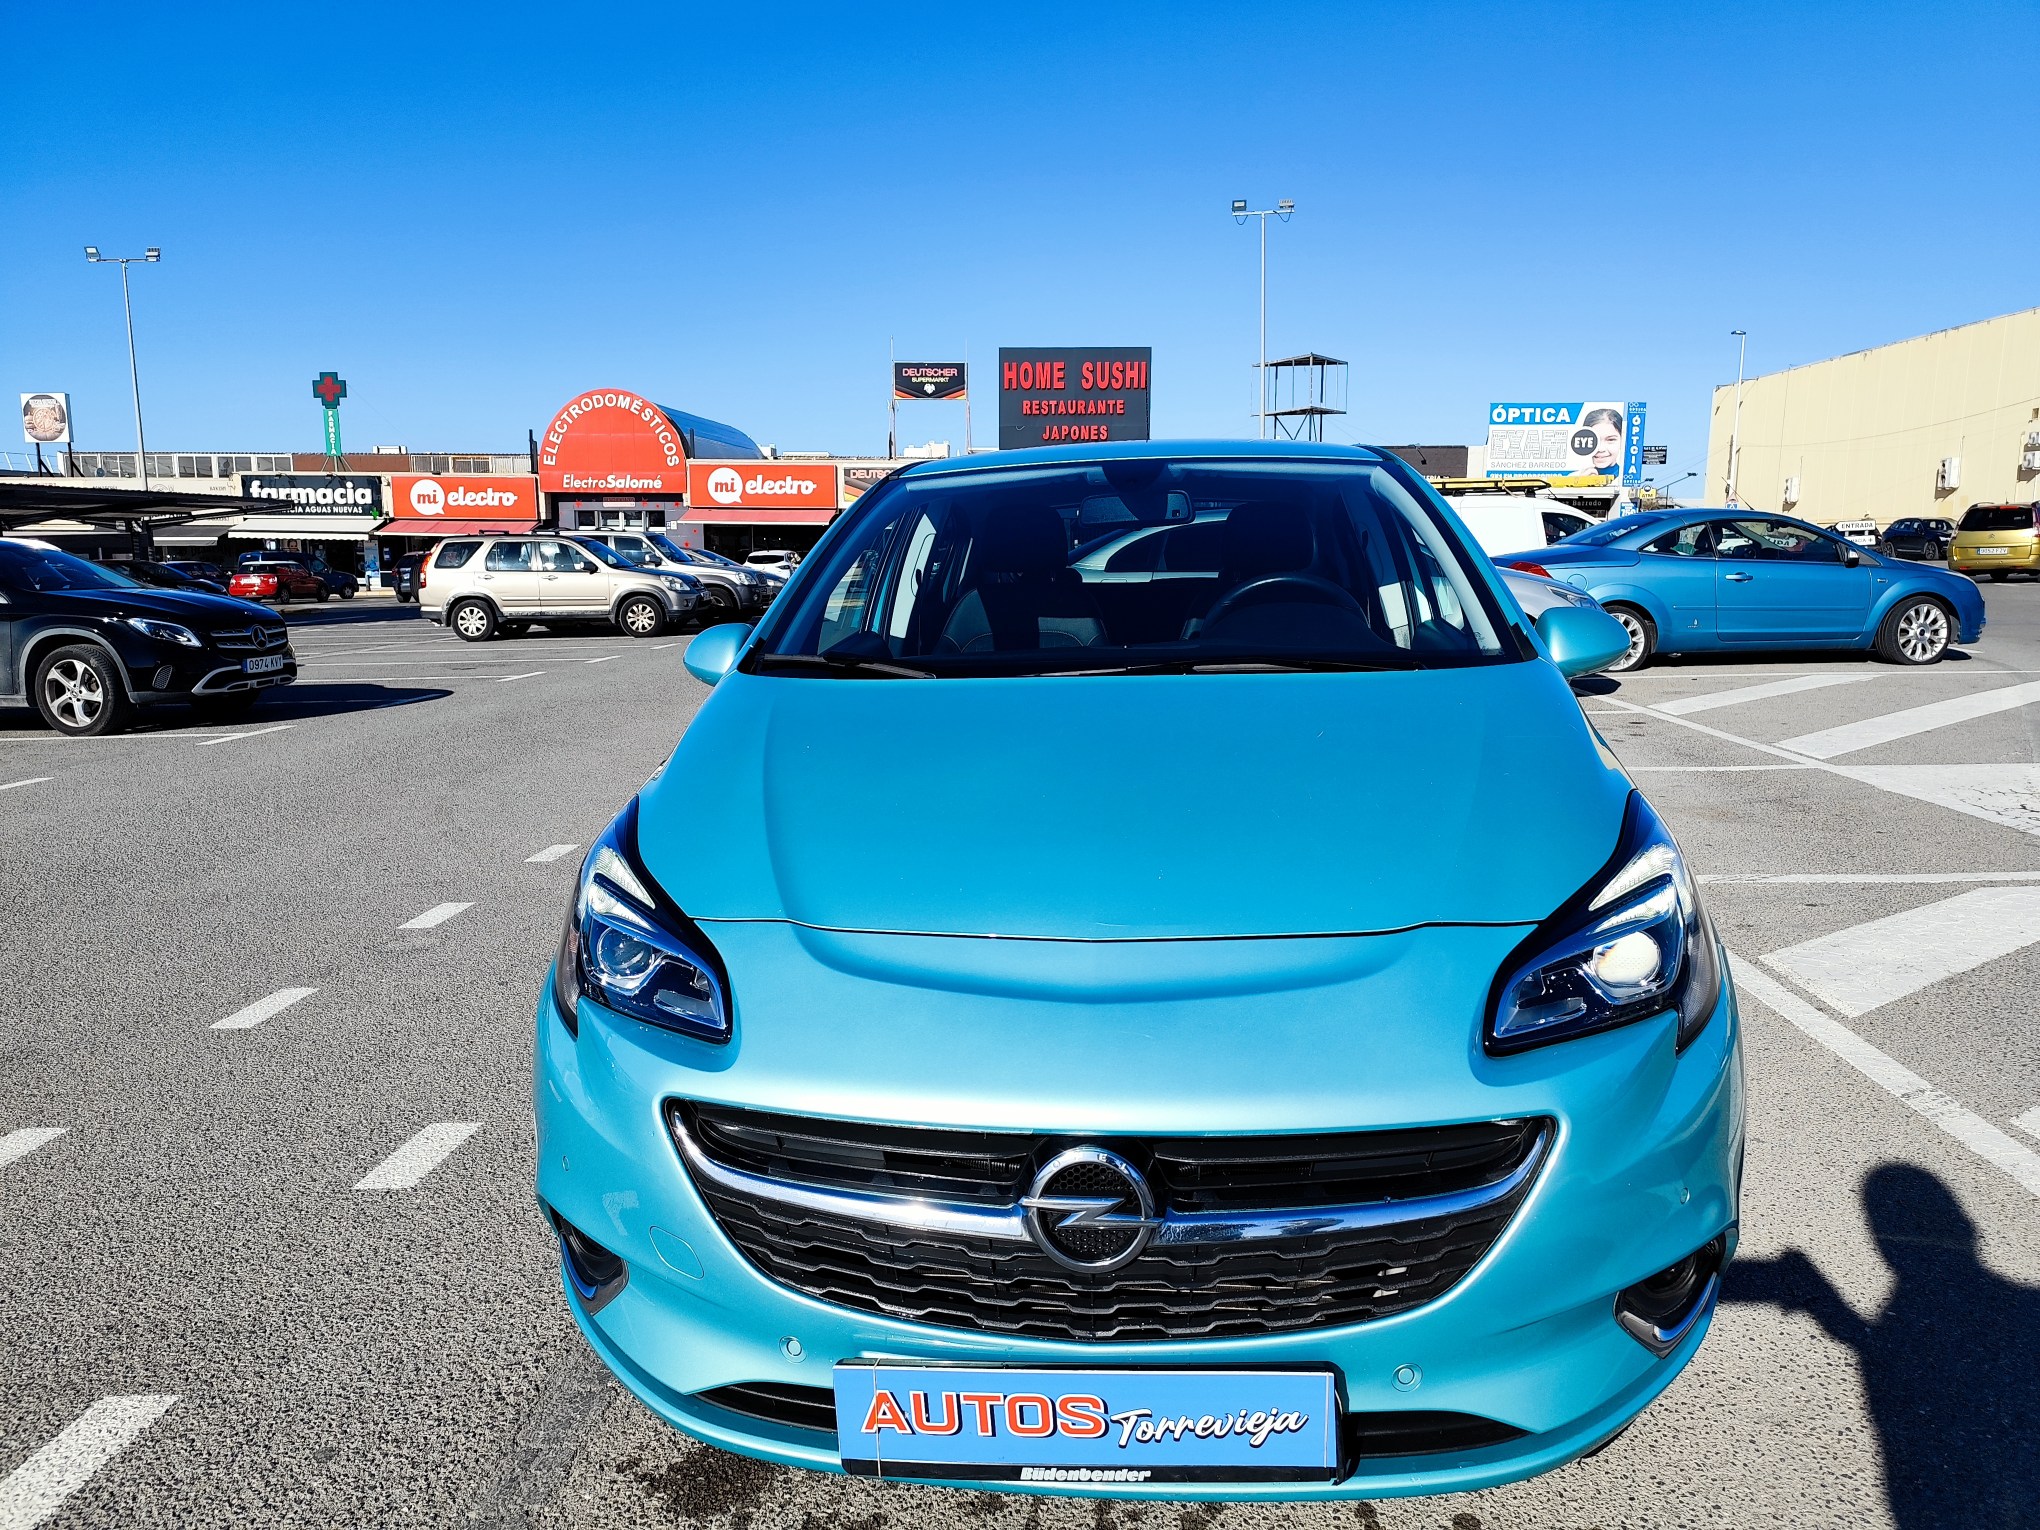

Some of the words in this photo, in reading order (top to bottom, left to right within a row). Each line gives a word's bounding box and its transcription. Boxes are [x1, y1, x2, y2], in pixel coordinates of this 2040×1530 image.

[902, 368, 958, 377] DEUTSCHER
[1003, 361, 1065, 390] HOME
[1081, 361, 1147, 390] SUSHI
[1022, 399, 1126, 415] RESTAURANTE
[1491, 405, 1571, 423] ÓPTICA
[327, 410, 337, 455] FARMACIA
[543, 393, 680, 467] ELECTRODOMÉSTICOS
[1042, 425, 1109, 441] JAPONES
[1573, 437, 1594, 448] EYE
[1490, 460, 1527, 469] SÁNCHEZ
[1528, 461, 1567, 469] BARREDO
[850, 469, 894, 479] DEUTSC
[249, 480, 373, 505] farmacia
[714, 477, 738, 493] mi
[744, 474, 818, 495] electro
[416, 490, 439, 504] mi
[446, 486, 519, 507] electro
[305, 506, 332, 514] AGUAS
[333, 506, 363, 514] NUEVAS
[1841, 522, 1874, 530] ENTRADA
[249, 658, 269, 671] 0974
[860, 1389, 1107, 1438] AUTOS
[1110, 1407, 1309, 1449] Torrevieja
[1019, 1467, 1152, 1482] Büdenbender
